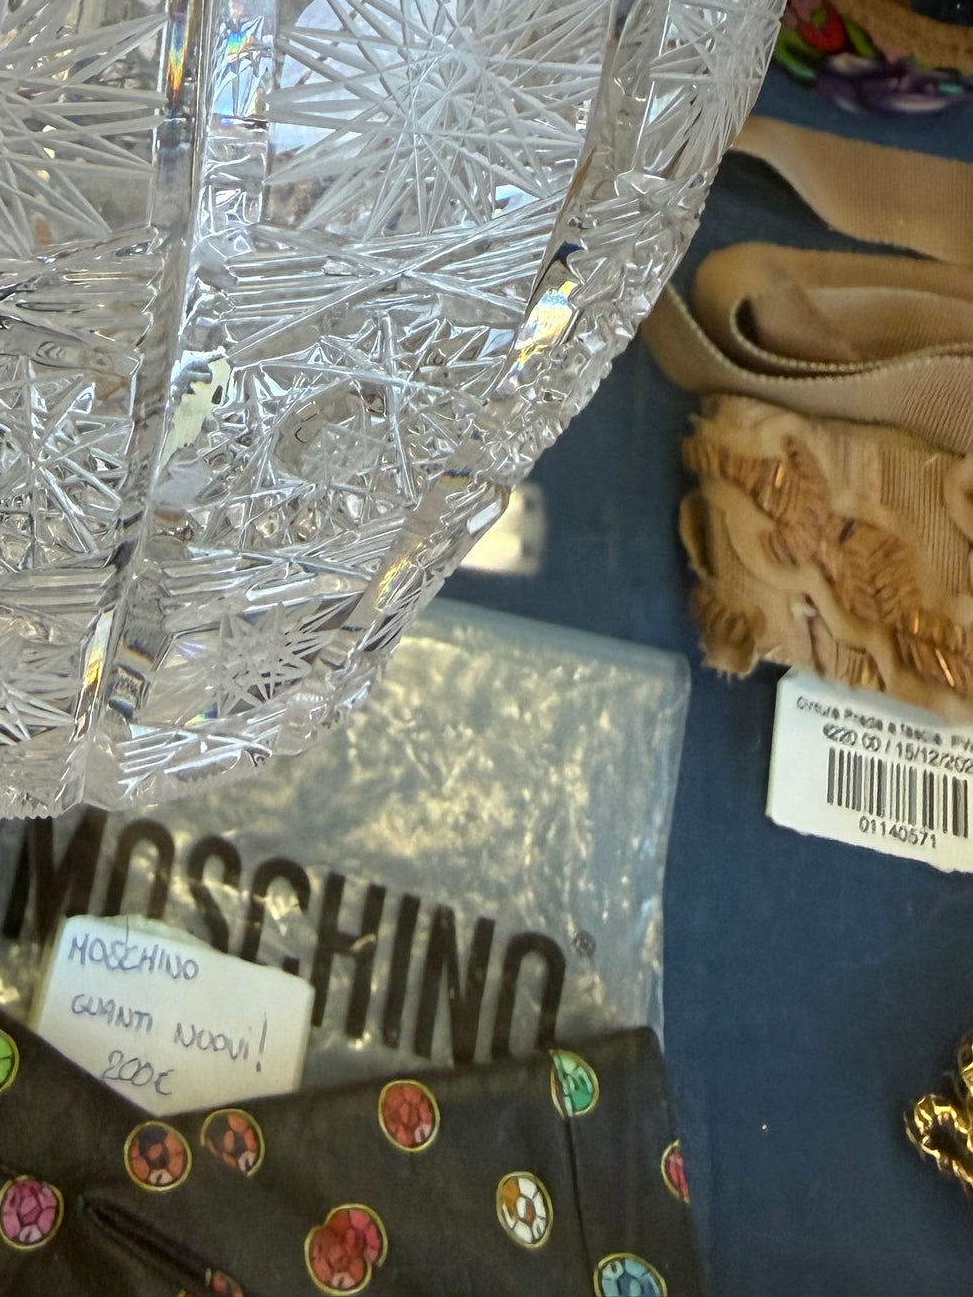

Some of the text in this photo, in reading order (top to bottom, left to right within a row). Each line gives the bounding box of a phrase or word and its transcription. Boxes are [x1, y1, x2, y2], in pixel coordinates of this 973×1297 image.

[896, 741, 973, 773] 15/12/202
[859, 816, 937, 850] 01140571
[67, 933, 200, 981] MOSCHINO
[70, 993, 154, 1033] GUANTI
[100, 1049, 175, 1096] 200€
